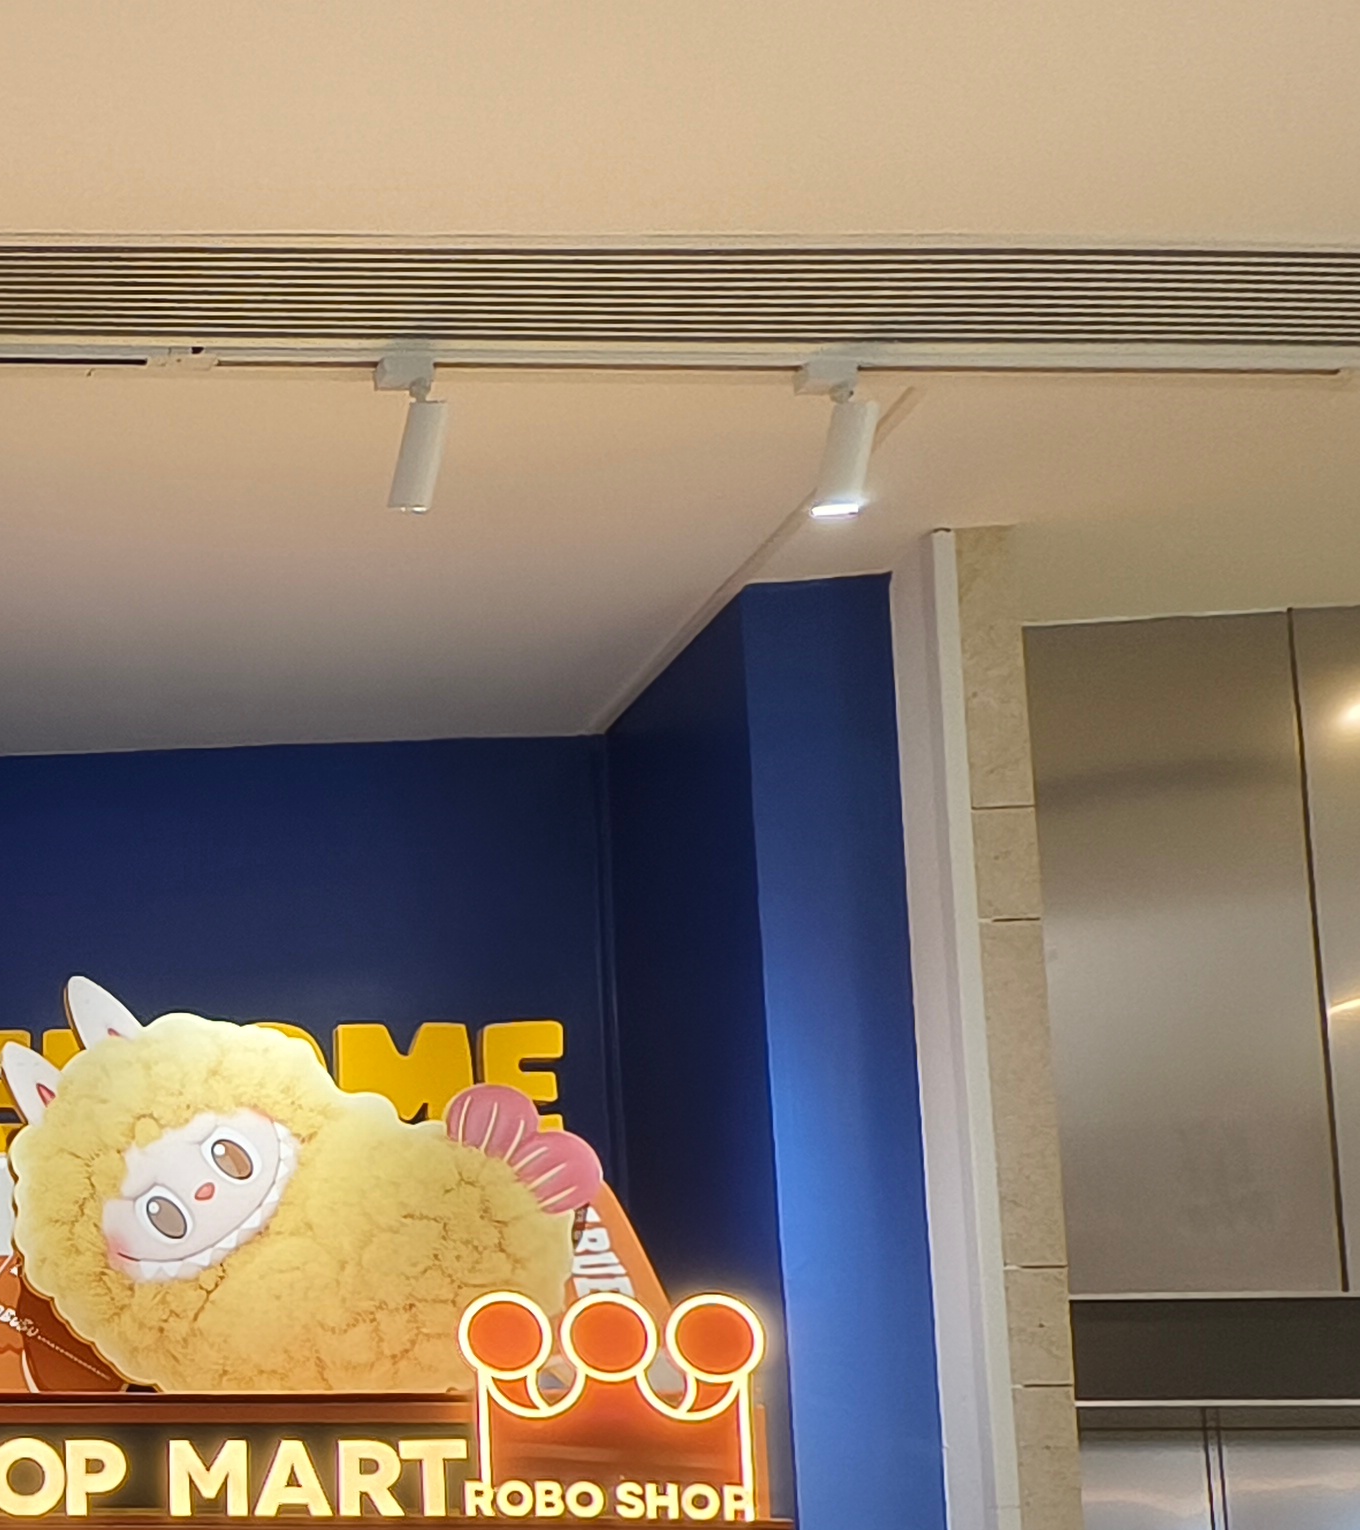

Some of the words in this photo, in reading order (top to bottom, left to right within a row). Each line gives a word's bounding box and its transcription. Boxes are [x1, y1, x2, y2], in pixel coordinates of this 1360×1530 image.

[167, 1437, 468, 1520] MART
[464, 1480, 605, 1519] ROBO
[615, 1481, 756, 1522] SHOP
